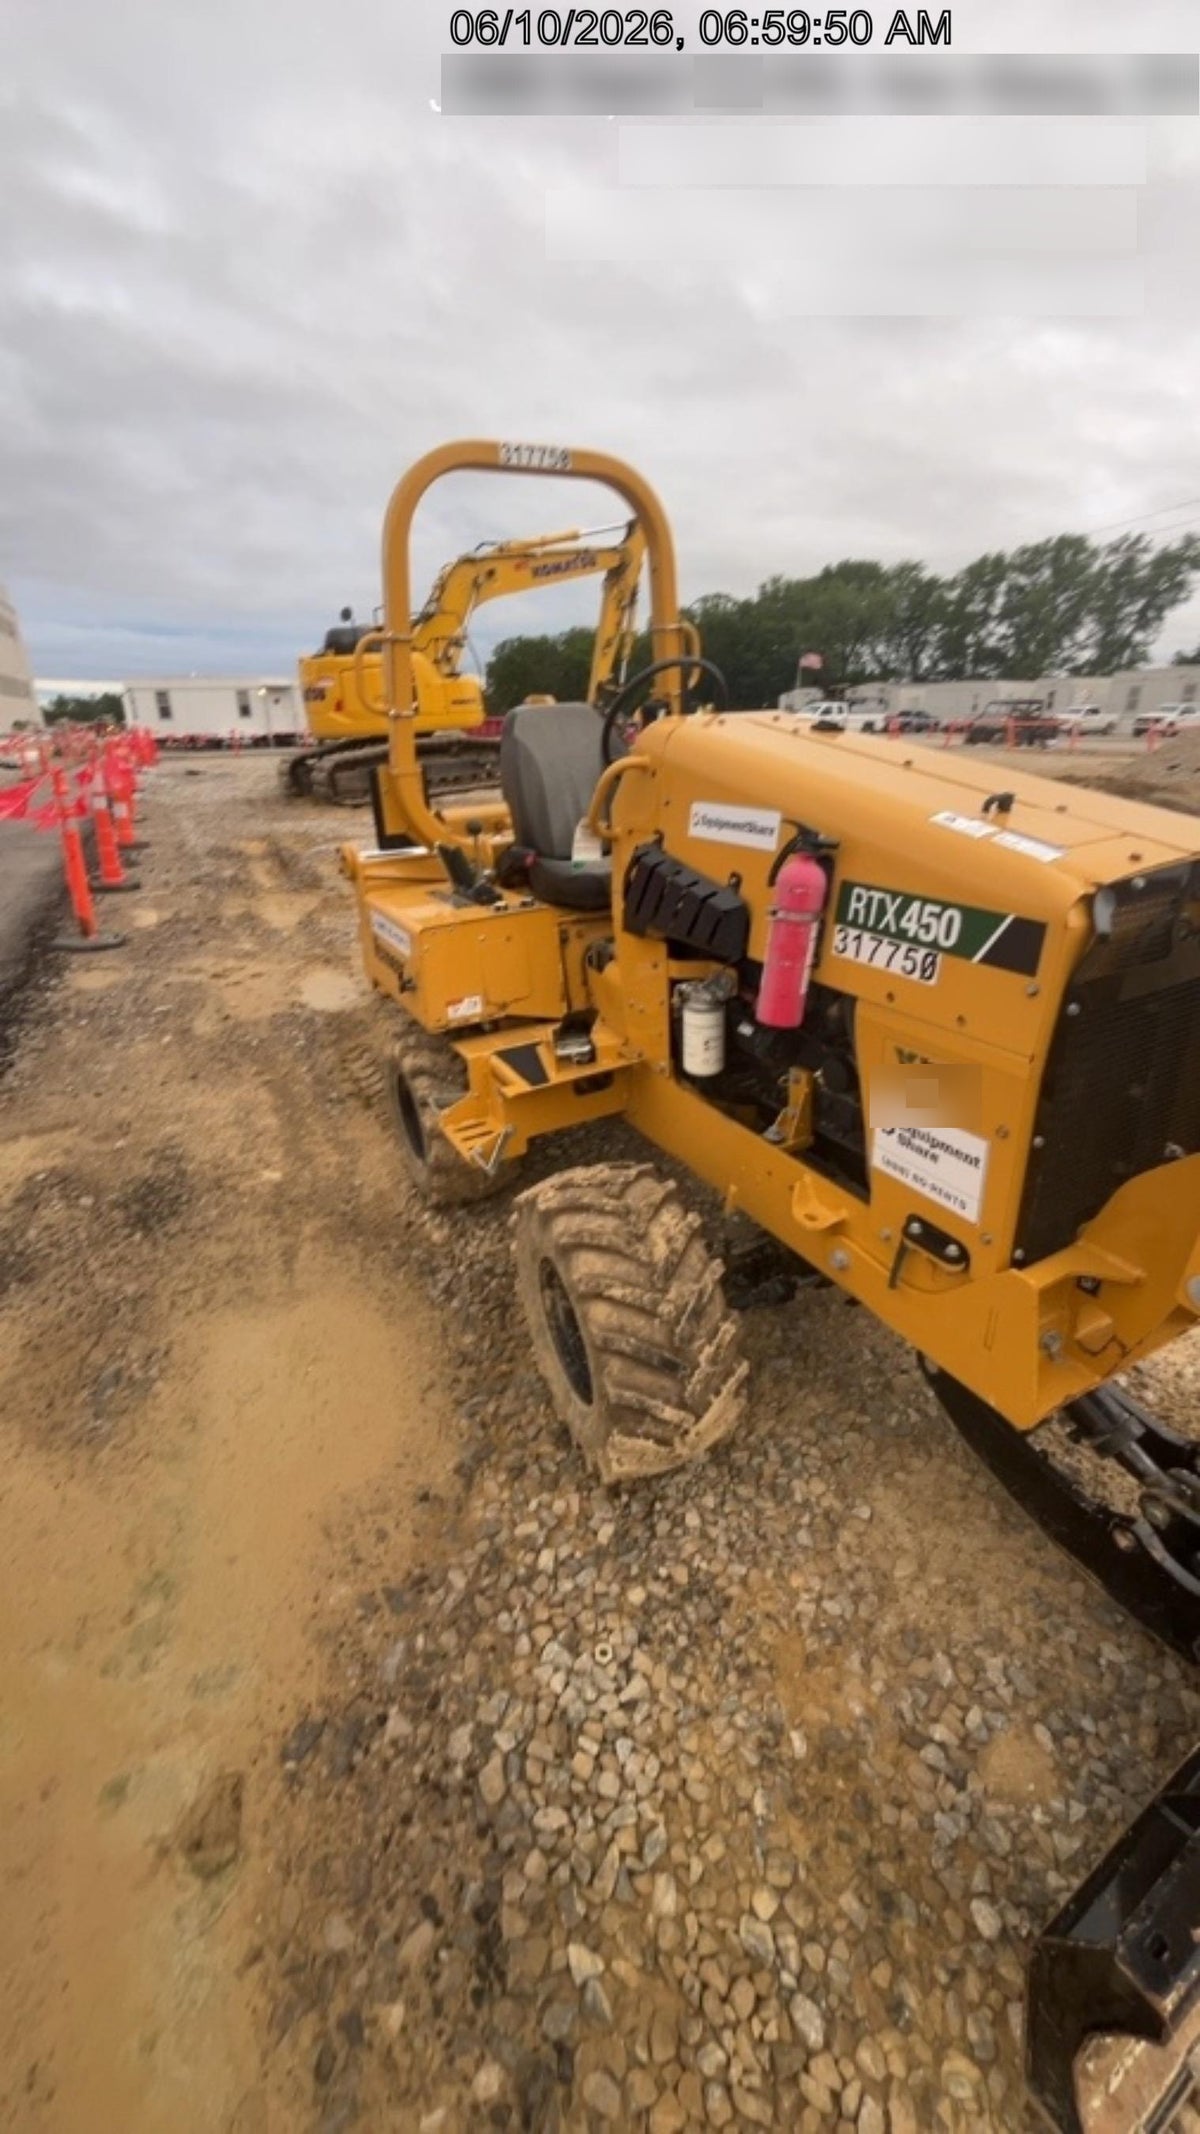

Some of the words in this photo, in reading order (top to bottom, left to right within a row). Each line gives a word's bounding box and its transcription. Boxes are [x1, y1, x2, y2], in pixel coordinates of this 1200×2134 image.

[531, 550, 597, 578] KOMATSU
[847, 886, 962, 948] RTX450
[834, 928, 938, 981] 317750
[897, 1132, 939, 1164] Share
